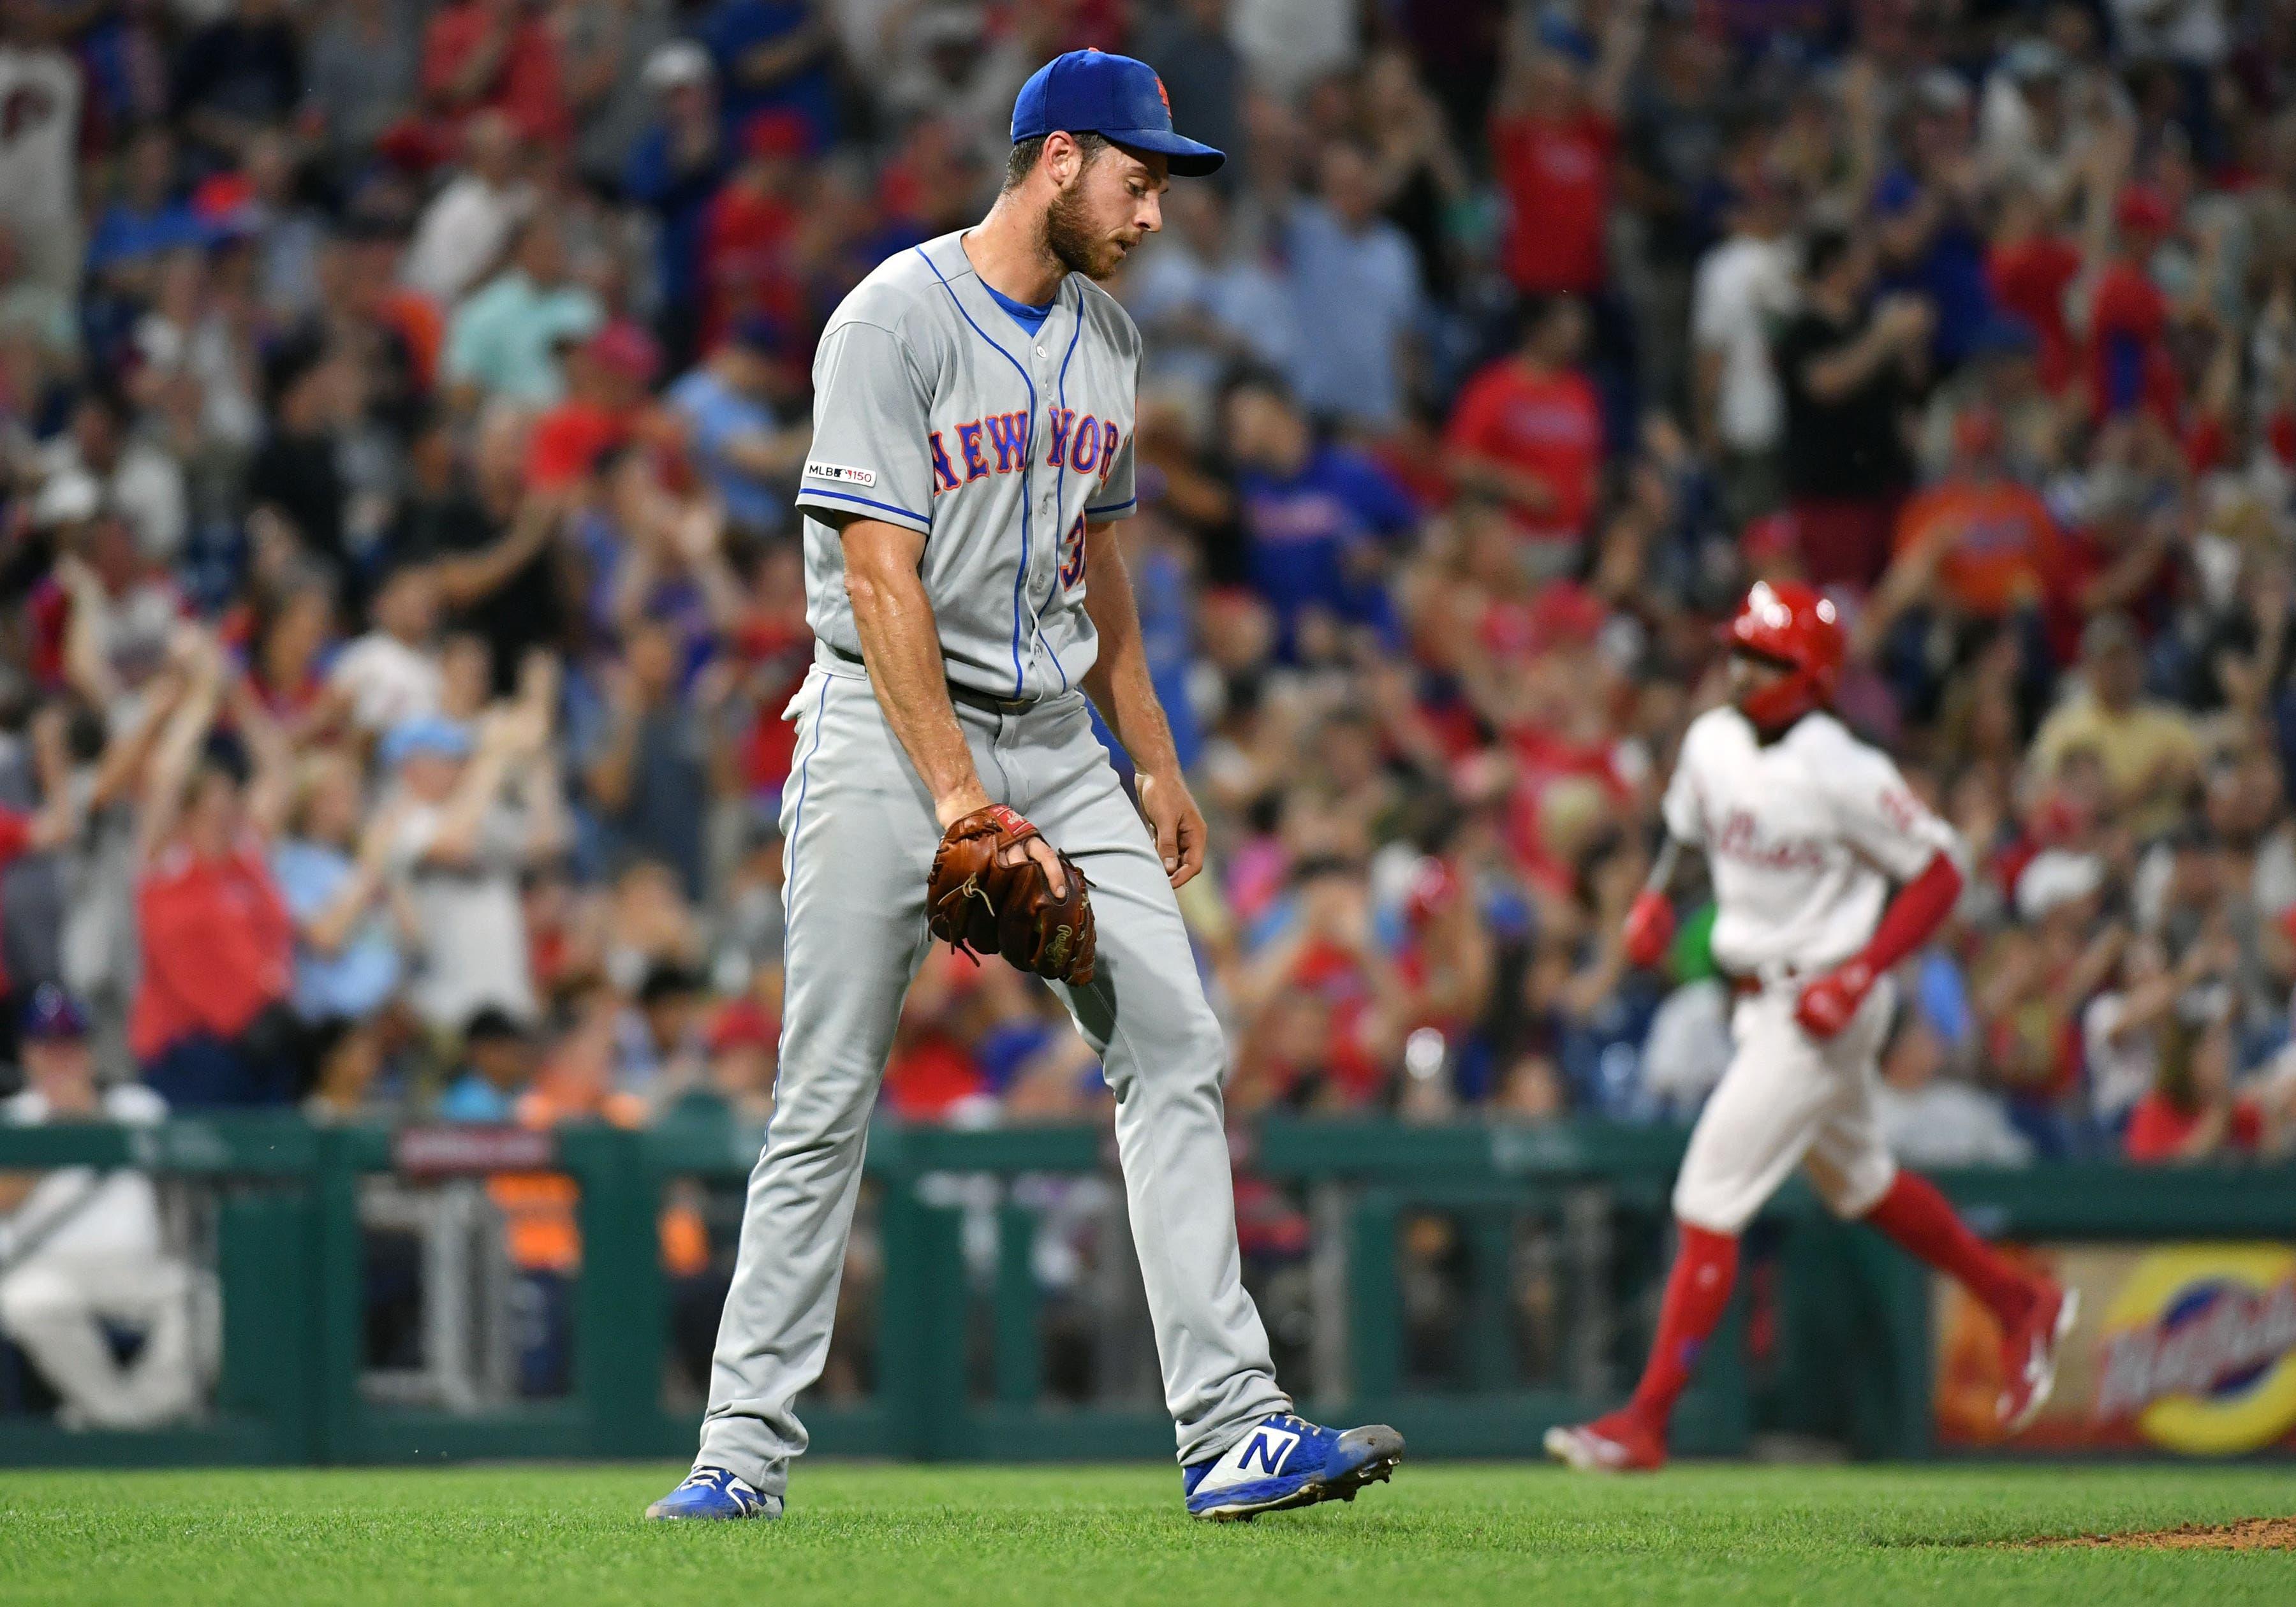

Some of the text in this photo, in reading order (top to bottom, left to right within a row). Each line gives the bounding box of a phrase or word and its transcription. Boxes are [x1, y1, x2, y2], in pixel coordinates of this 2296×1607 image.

[809, 465, 872, 483] MLB 150
[1047, 406, 1120, 490] YOR
[1059, 511, 1085, 592] 3
[1237, 1432, 1293, 1474] N
